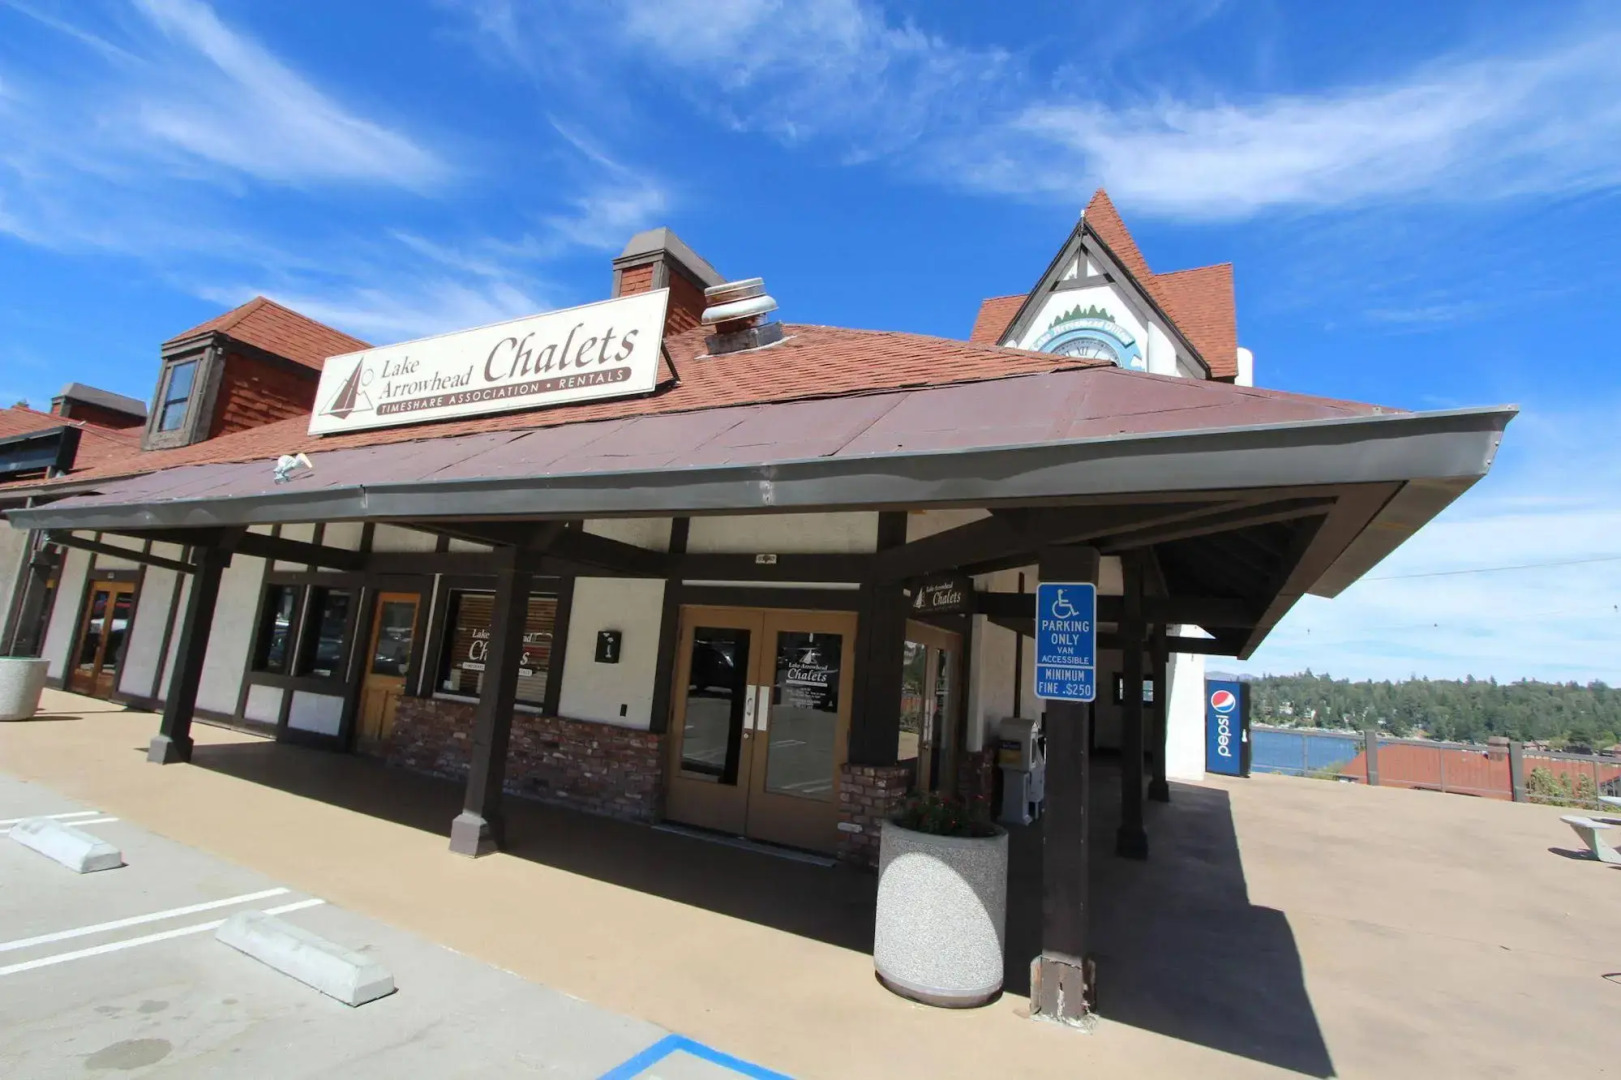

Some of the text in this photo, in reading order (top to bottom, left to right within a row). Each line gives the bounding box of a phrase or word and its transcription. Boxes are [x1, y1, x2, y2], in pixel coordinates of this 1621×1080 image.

[484, 322, 639, 382] Chalets
[381, 355, 420, 378] Lake
[379, 365, 474, 400] Arrowhead
[381, 369, 625, 414] TIMESHARE ASSOCIATION RENTALS
[472, 628, 490, 639] Lake
[1042, 620, 1090, 633] PARKING
[1051, 633, 1080, 646] ONLY
[1057, 646, 1074, 655] VAN
[1042, 655, 1090, 665] ACCESSIBLE
[787, 668, 828, 682] Chalets
[1045, 668, 1085, 682] MINIMUM
[1038, 681, 1059, 694] FINE
[1215, 714, 1232, 757] pepsi
